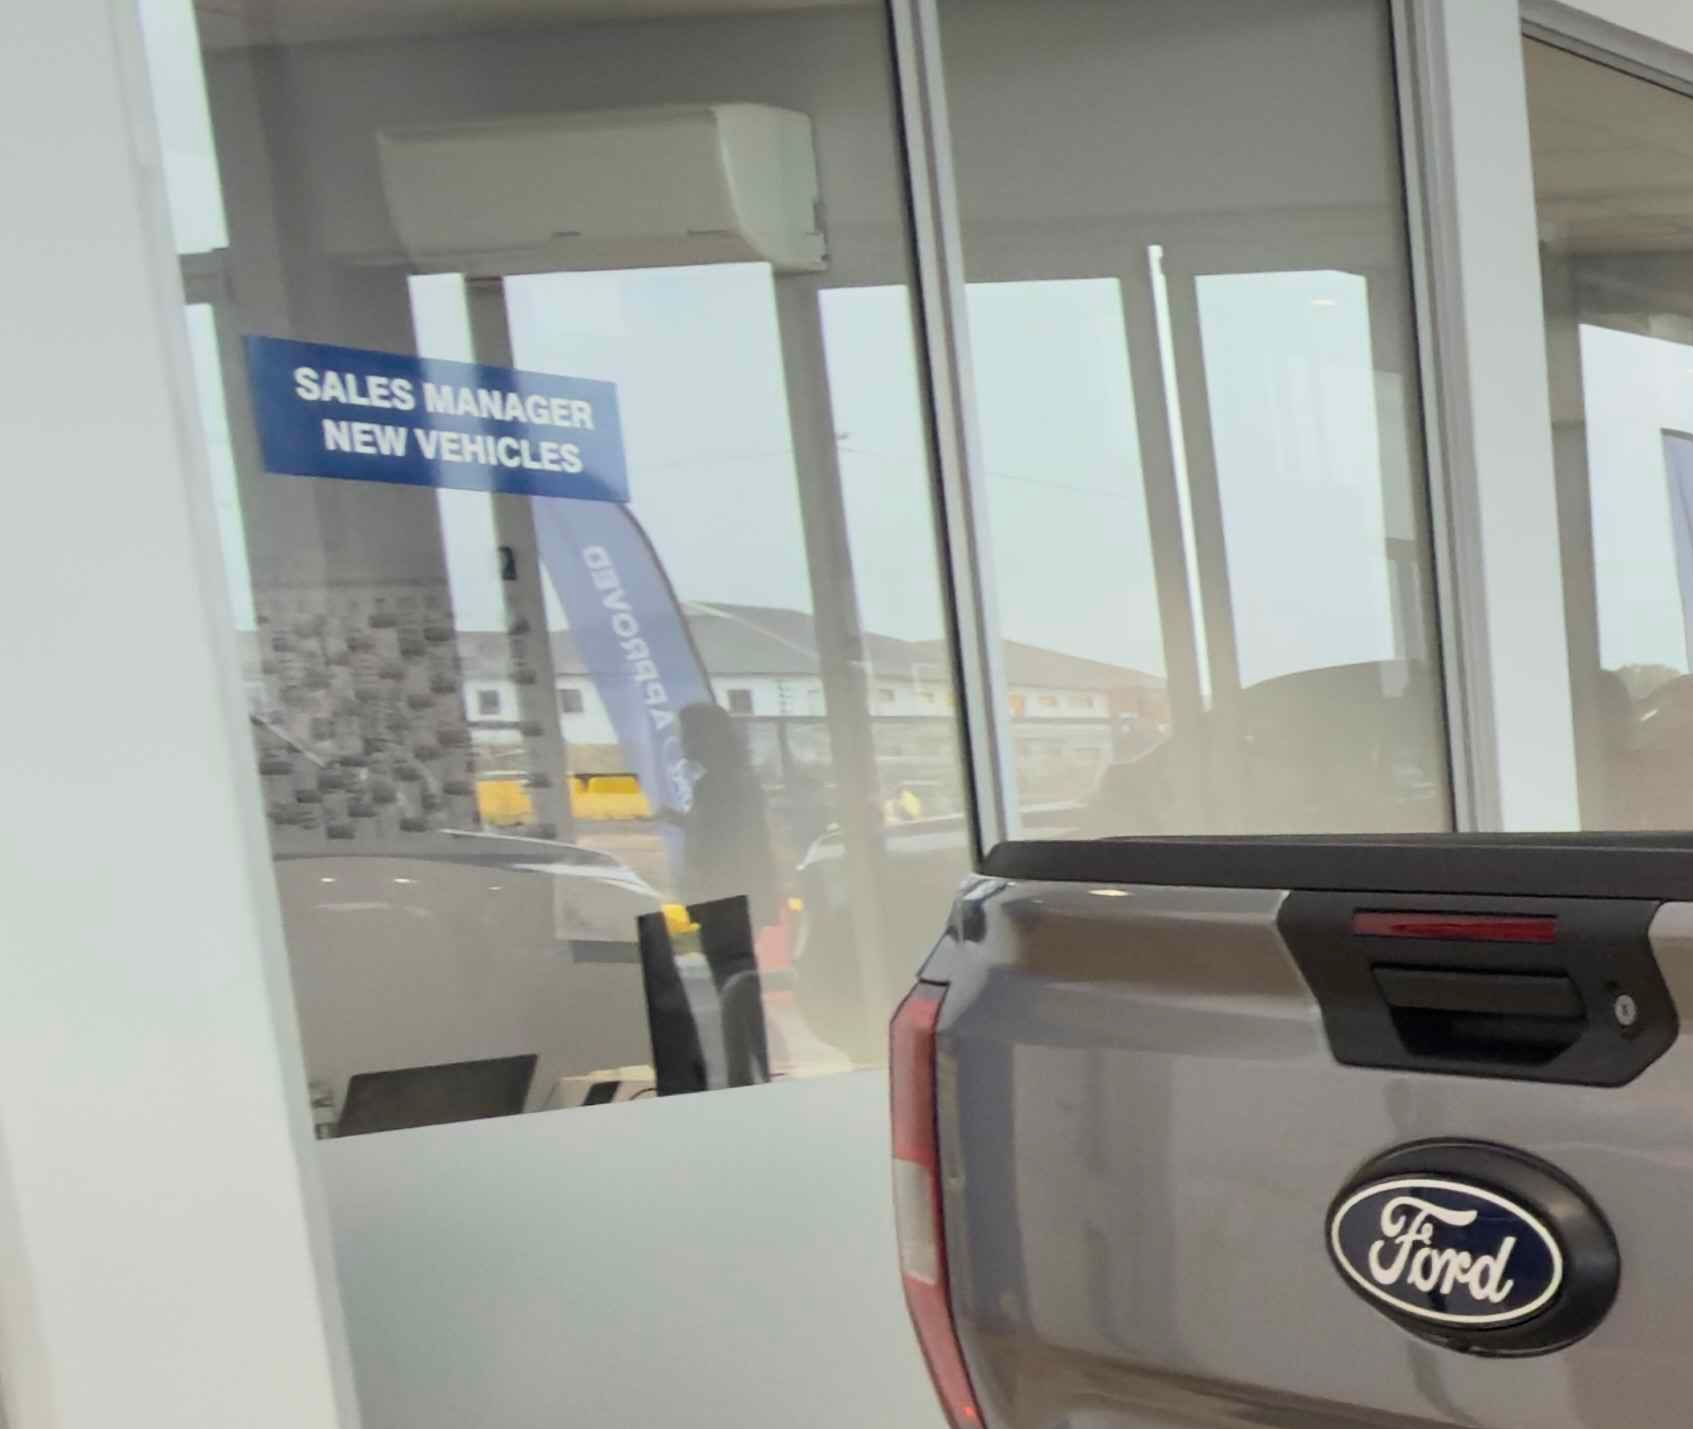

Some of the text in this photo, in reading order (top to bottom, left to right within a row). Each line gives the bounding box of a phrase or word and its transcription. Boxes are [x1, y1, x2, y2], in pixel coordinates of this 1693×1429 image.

[294, 366, 595, 431] SALES MANAGER
[322, 418, 584, 474] NEW VEHICLES
[1368, 1196, 1517, 1303] Ford
